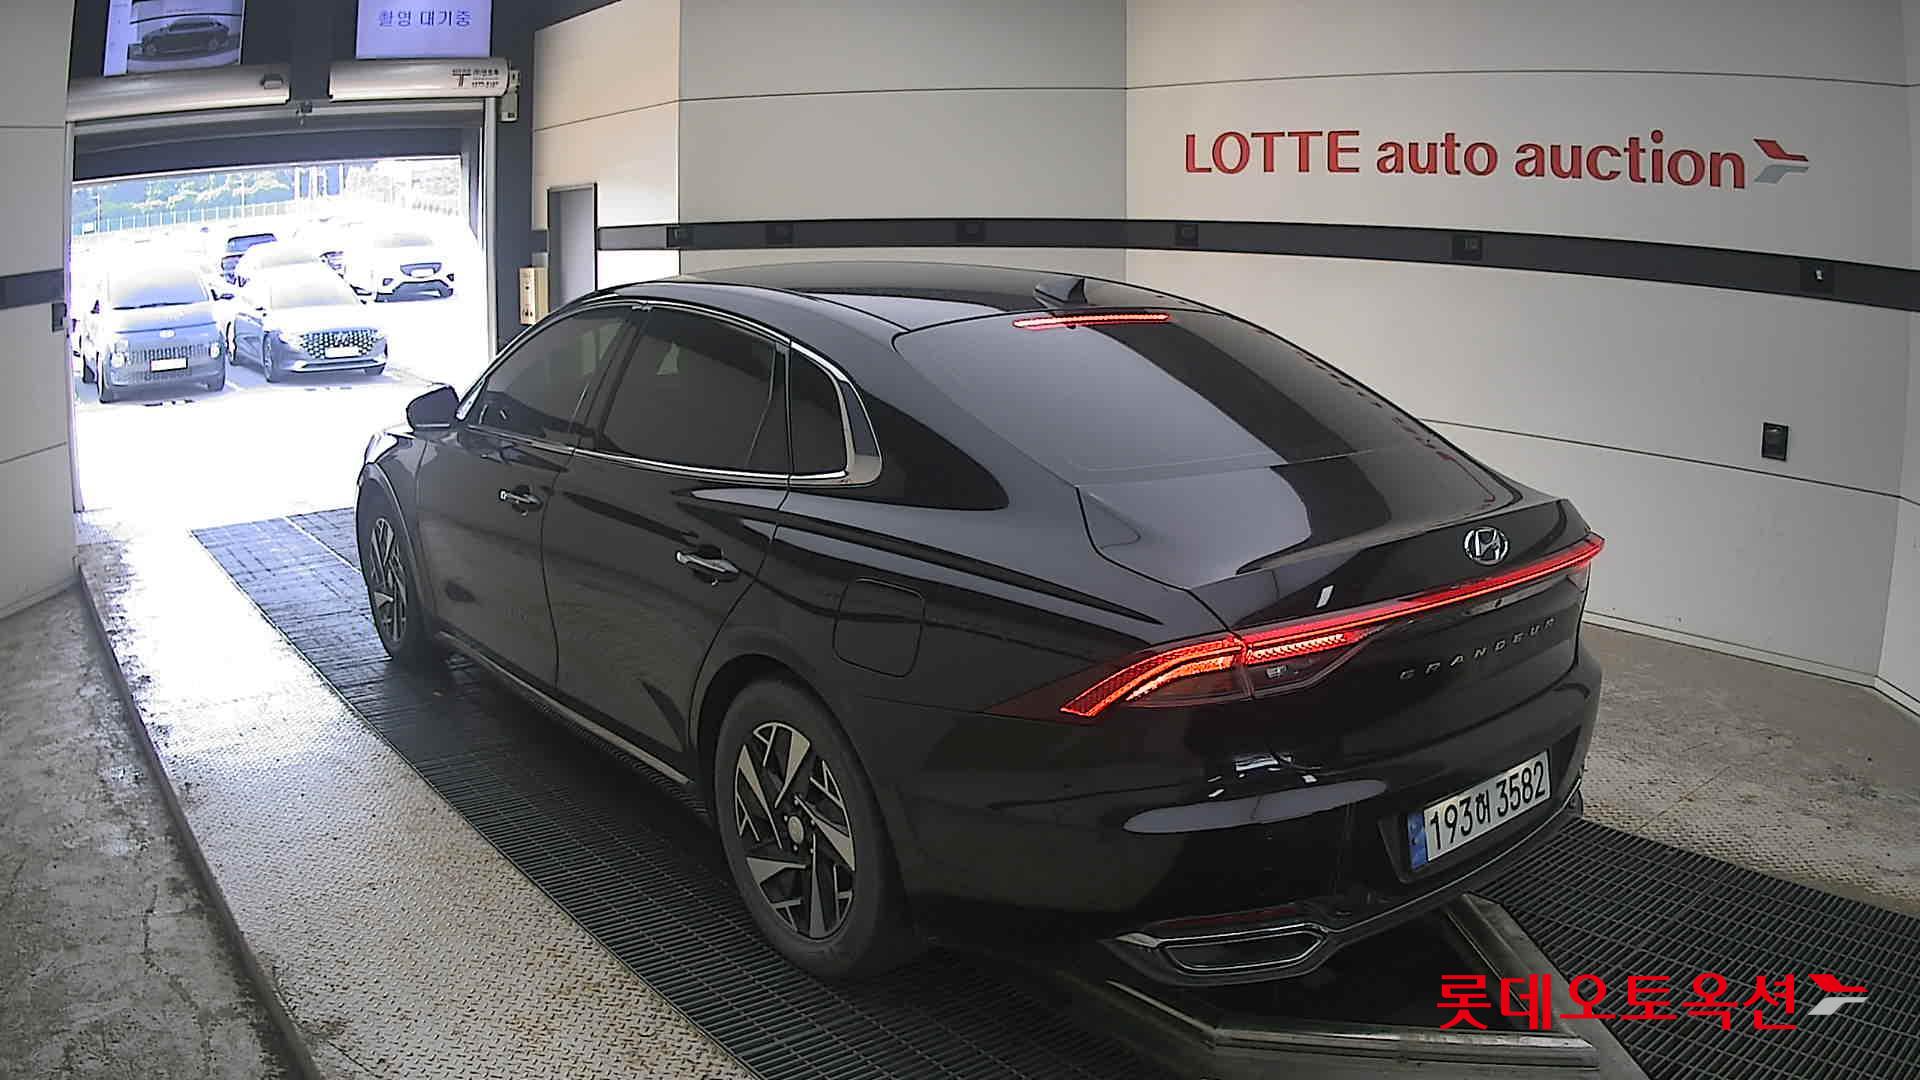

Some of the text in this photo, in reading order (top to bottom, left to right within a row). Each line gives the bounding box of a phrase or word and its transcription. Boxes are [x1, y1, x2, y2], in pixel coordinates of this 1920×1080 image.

[420, 10, 471, 27] 대기중
[1185, 129, 1746, 189] LOTTE auto auction
[1400, 618, 1556, 680] GRANDEUR
[1429, 761, 1546, 850] 193허 3582
